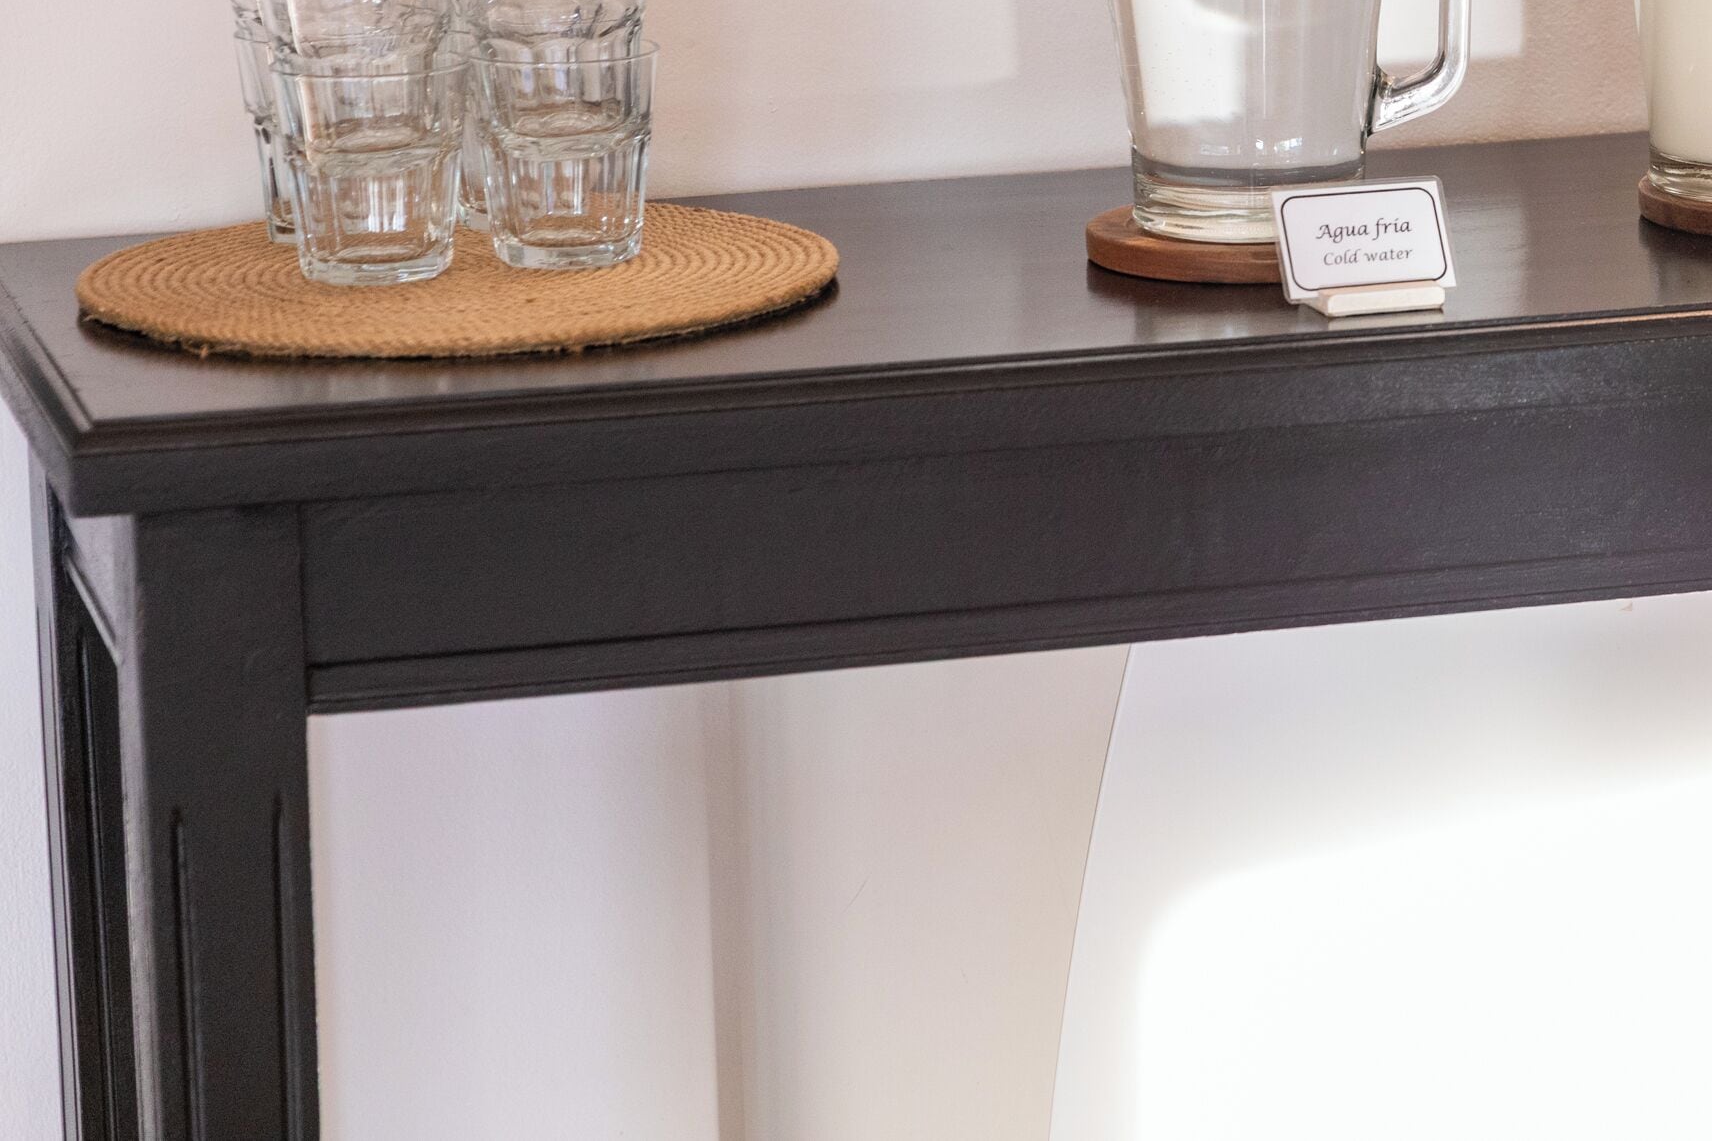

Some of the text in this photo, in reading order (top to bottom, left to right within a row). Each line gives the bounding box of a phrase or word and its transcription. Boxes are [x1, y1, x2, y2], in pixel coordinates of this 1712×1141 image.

[1315, 217, 1412, 244] Agua fría
[1323, 248, 1413, 266] Cold water
